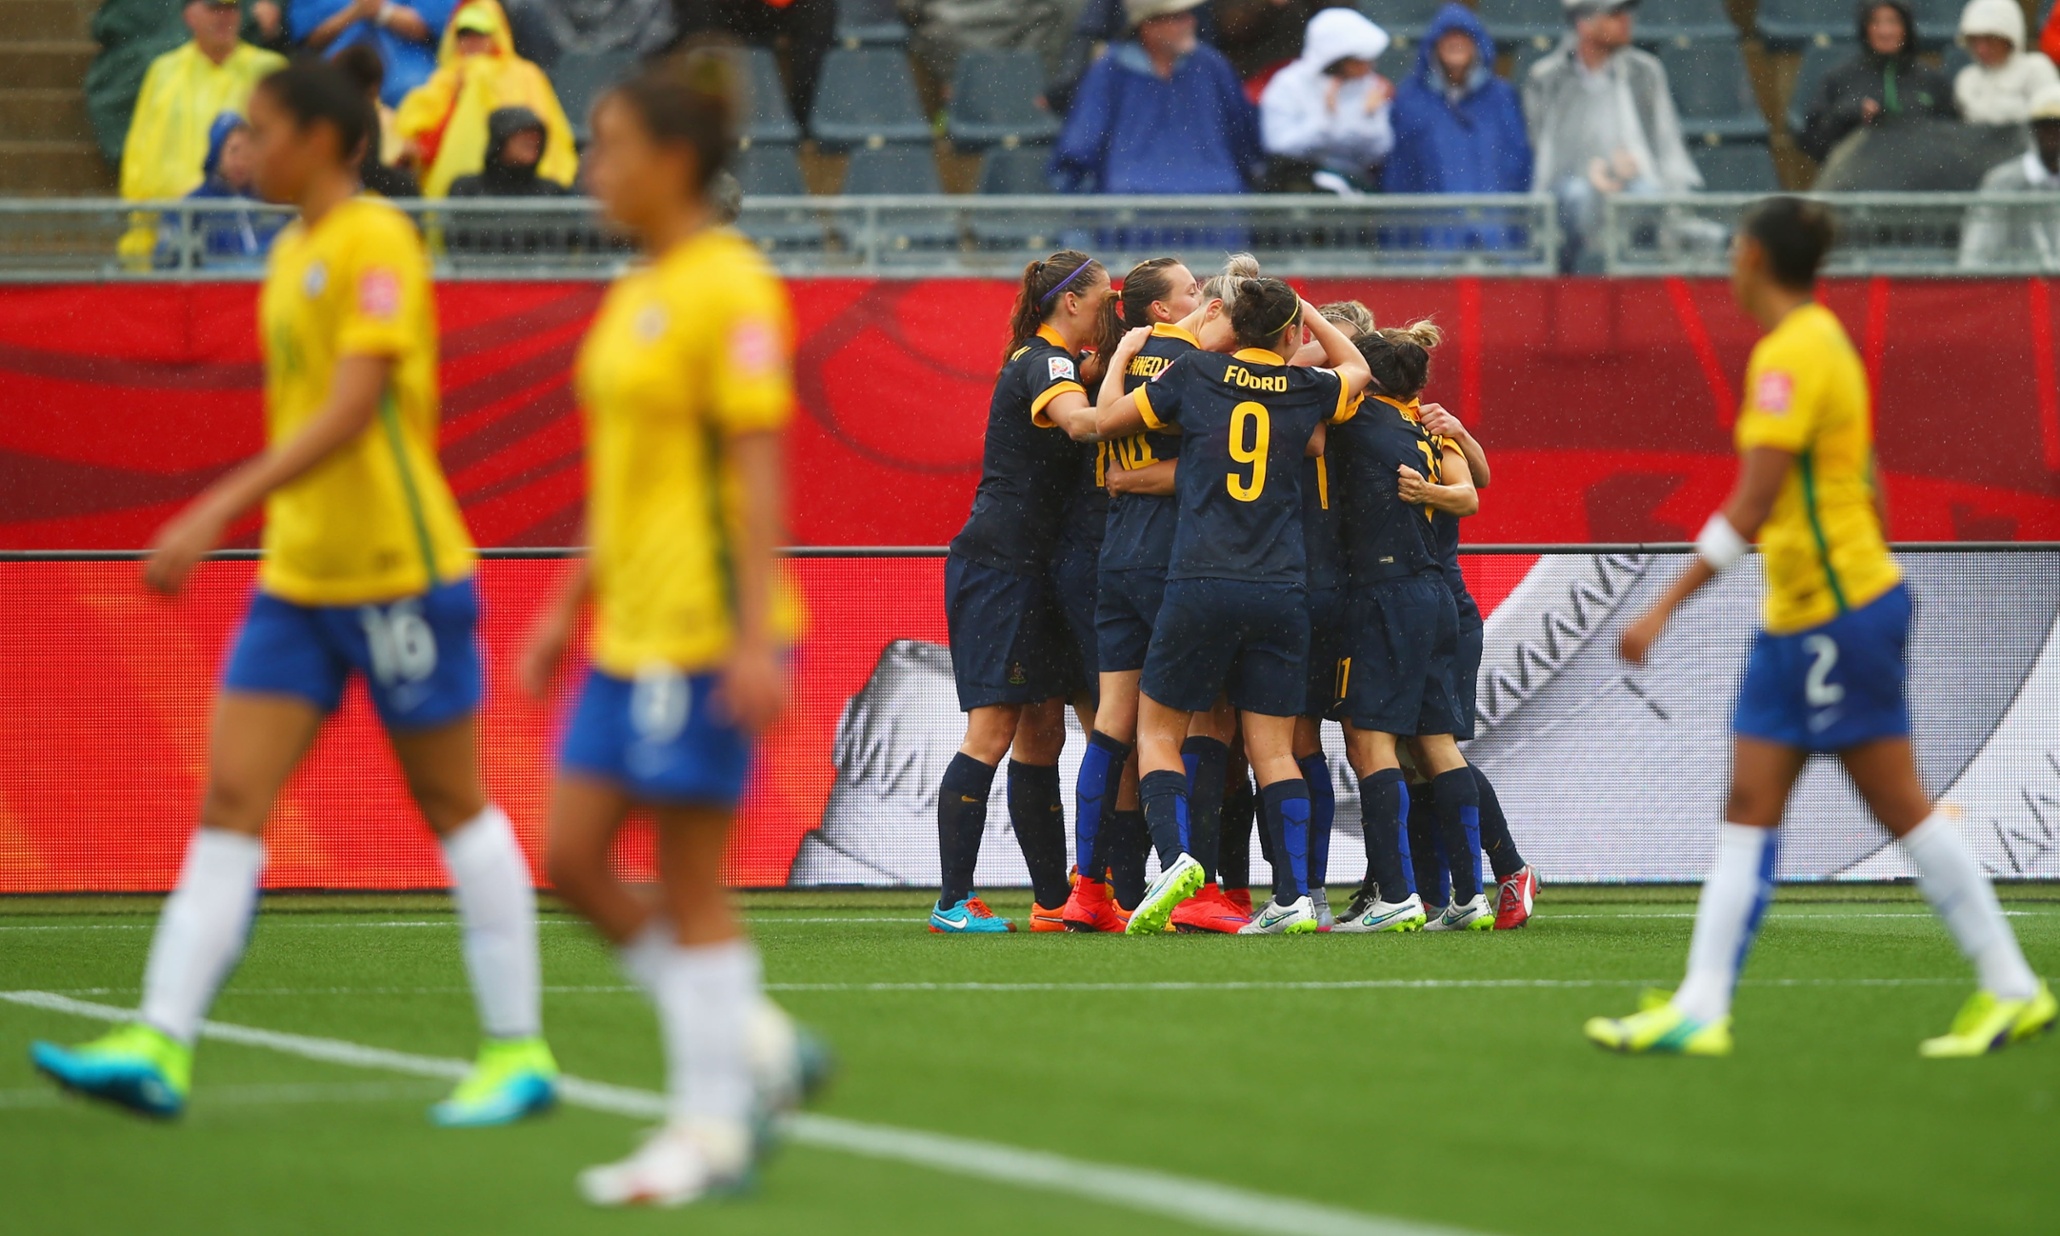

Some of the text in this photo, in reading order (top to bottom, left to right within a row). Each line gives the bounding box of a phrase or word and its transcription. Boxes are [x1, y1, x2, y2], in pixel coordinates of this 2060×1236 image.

[1223, 365, 1288, 393] FOORD
[1227, 401, 1270, 502] 9
[360, 600, 438, 685] 16
[1802, 634, 1845, 707] 2
